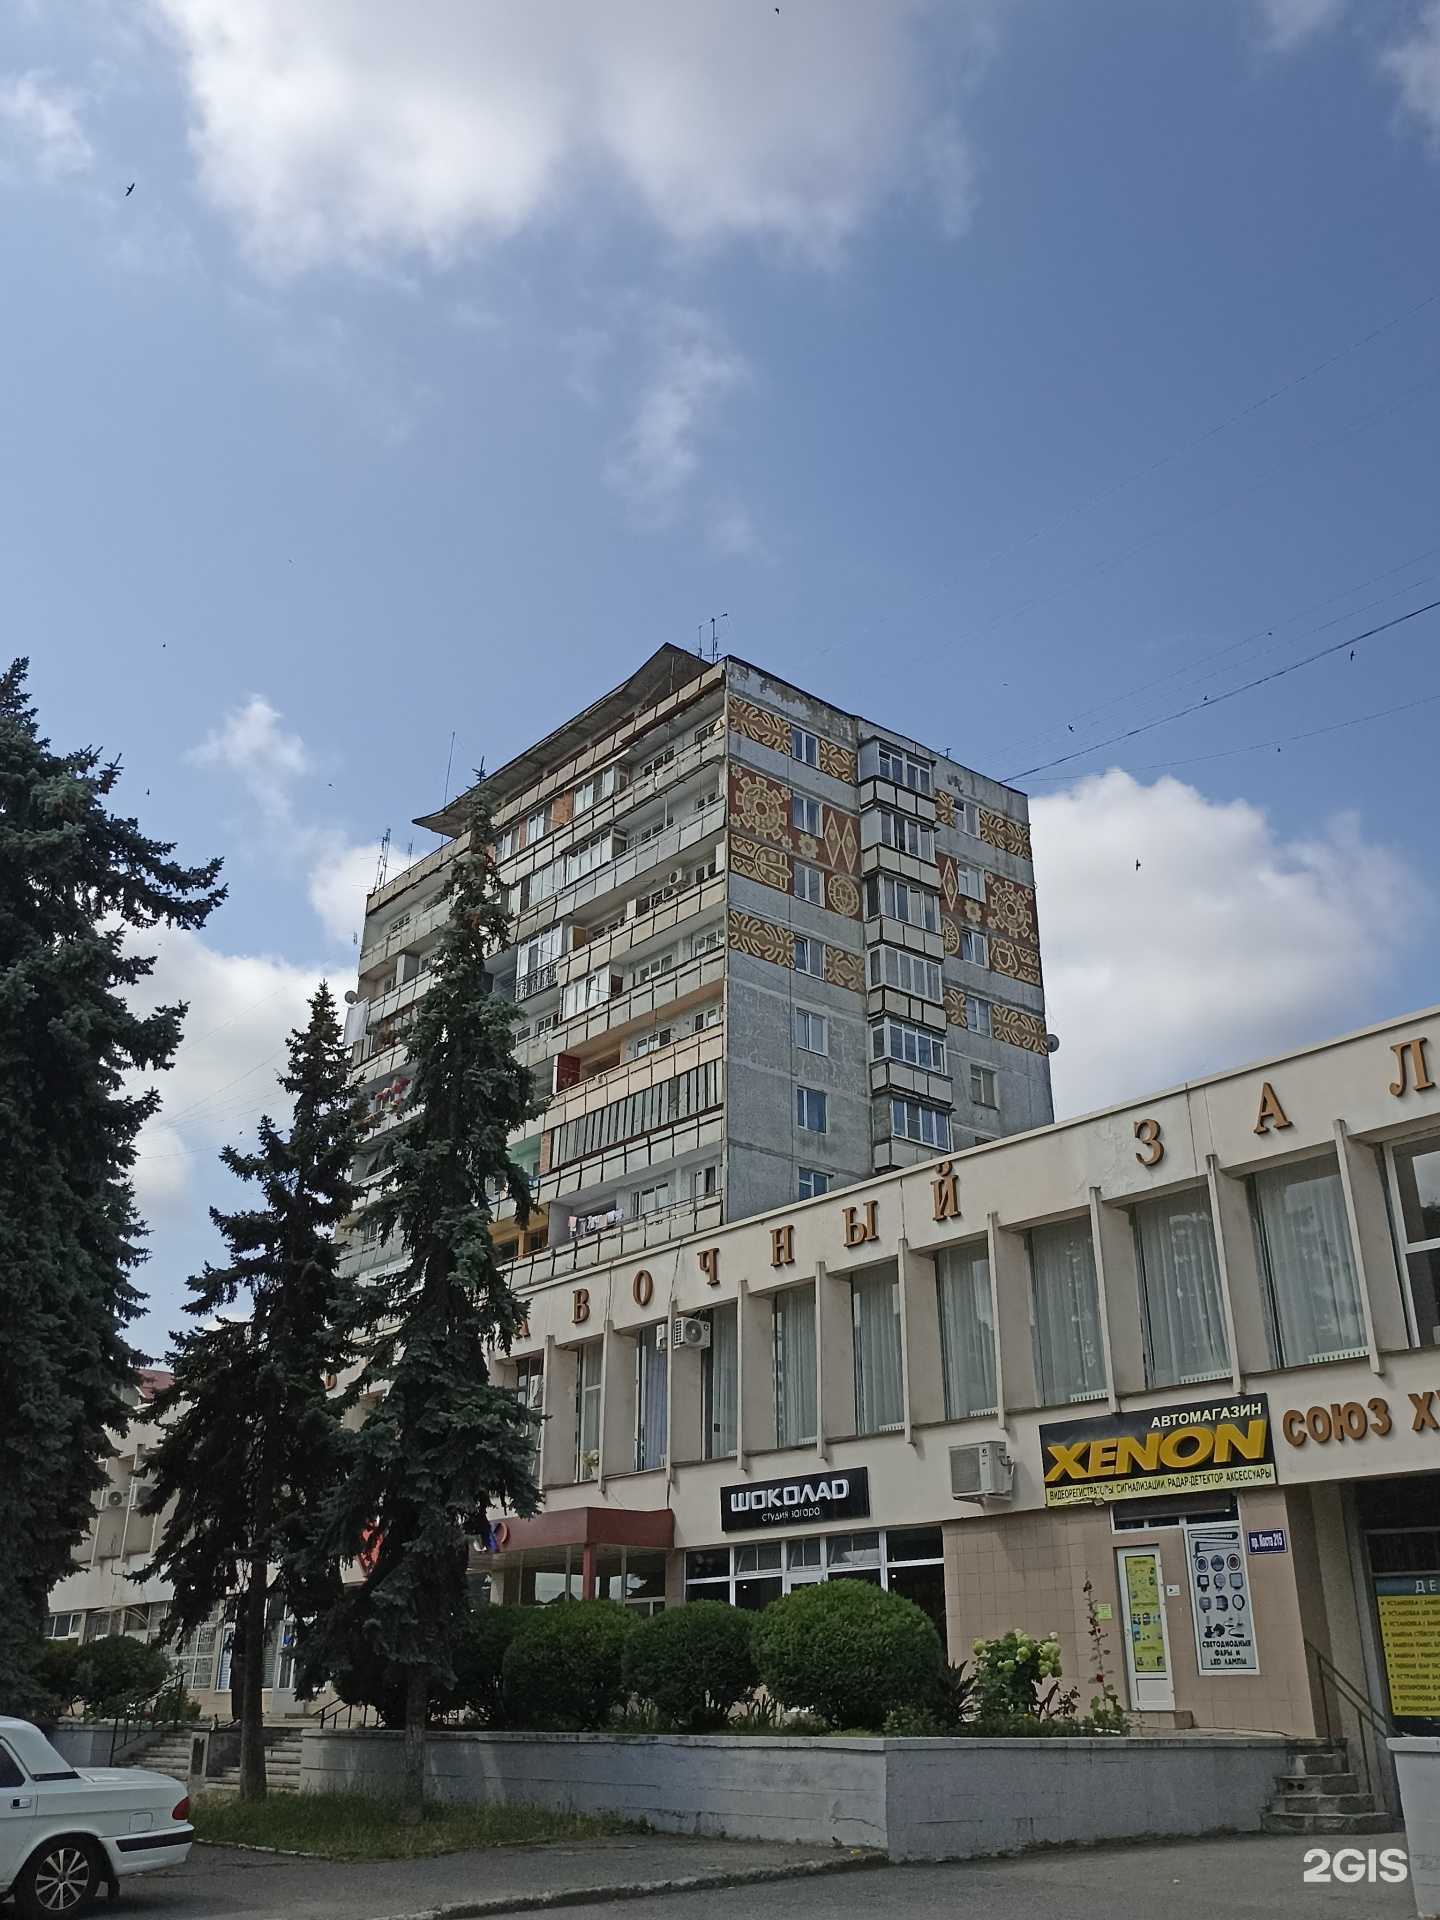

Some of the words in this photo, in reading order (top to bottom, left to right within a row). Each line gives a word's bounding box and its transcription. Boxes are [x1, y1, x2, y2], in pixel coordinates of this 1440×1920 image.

[1134, 1037, 1436, 1167] ЗАЛ
[1151, 1403, 1262, 1428] АВТОМАГАЗИН
[1283, 1398, 1392, 1447] СОЮЗ
[1044, 1419, 1267, 1482] XENON
[731, 1479, 849, 1512] ШОКОЛАД
[1226, 1468, 1271, 1482] АКСЕССУАРЫ
